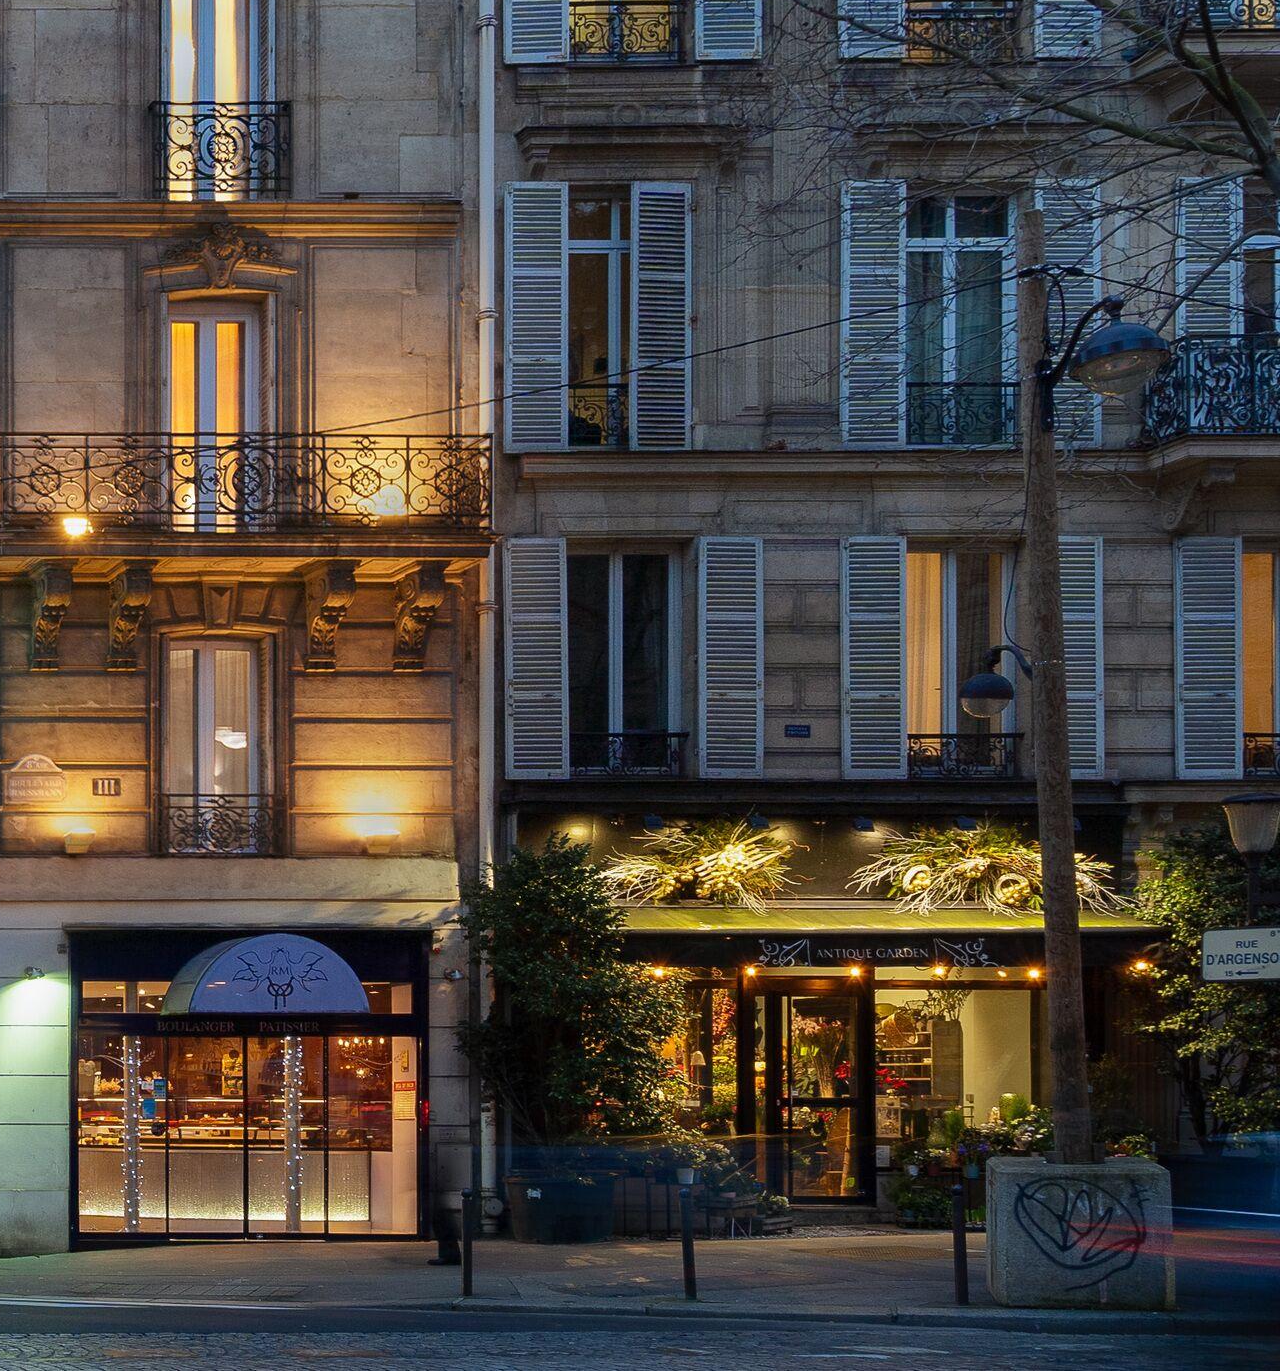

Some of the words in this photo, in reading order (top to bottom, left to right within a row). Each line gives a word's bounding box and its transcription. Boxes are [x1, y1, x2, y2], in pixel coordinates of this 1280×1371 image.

[1235, 939, 1259, 949] RUE
[816, 947, 872, 960] ANTIQUE
[876, 947, 930, 959] GARDEN
[1206, 952, 1279, 966] D'ARGENSO
[270, 965, 290, 976] RM
[157, 1020, 236, 1033] BOULANGER
[258, 1020, 320, 1033] PATISSIER
